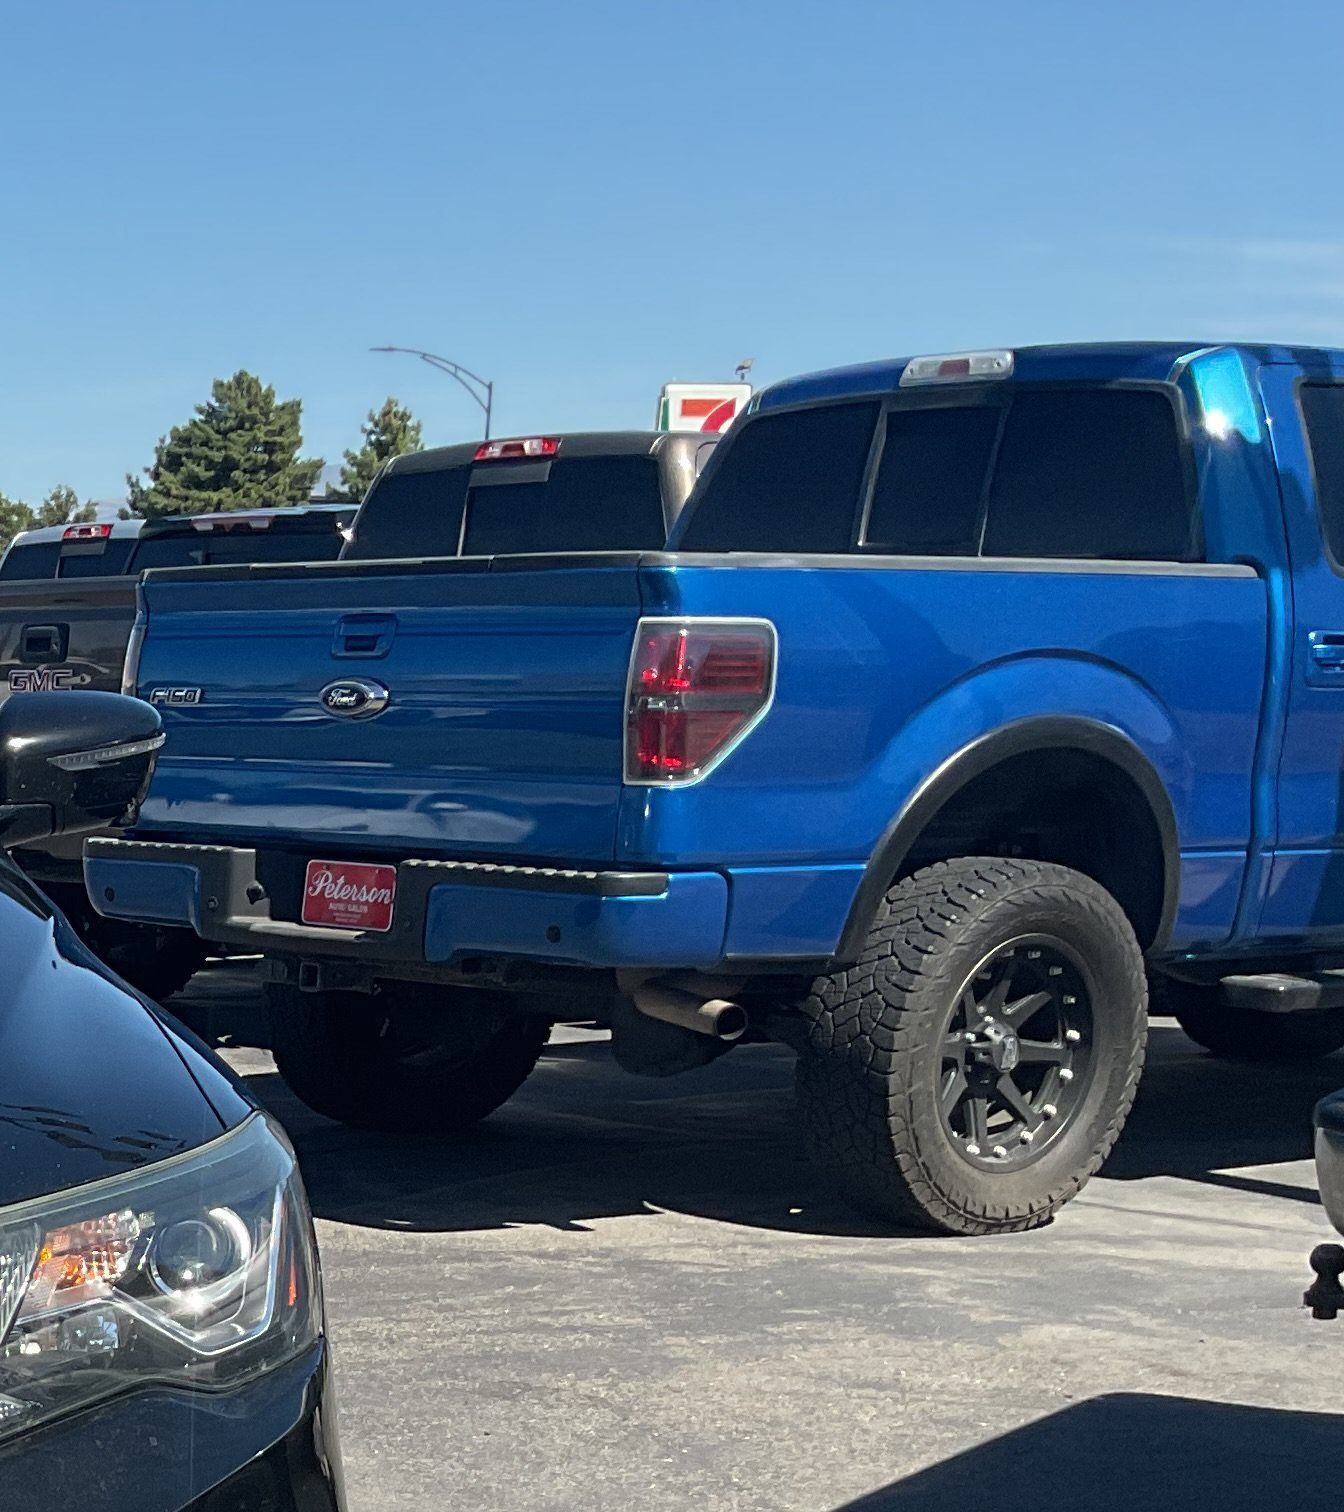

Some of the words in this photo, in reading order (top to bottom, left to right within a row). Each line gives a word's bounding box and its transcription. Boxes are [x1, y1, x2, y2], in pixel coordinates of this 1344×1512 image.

[8, 669, 74, 692] GMC
[327, 688, 357, 706] Ford
[309, 869, 391, 904] Peterson
